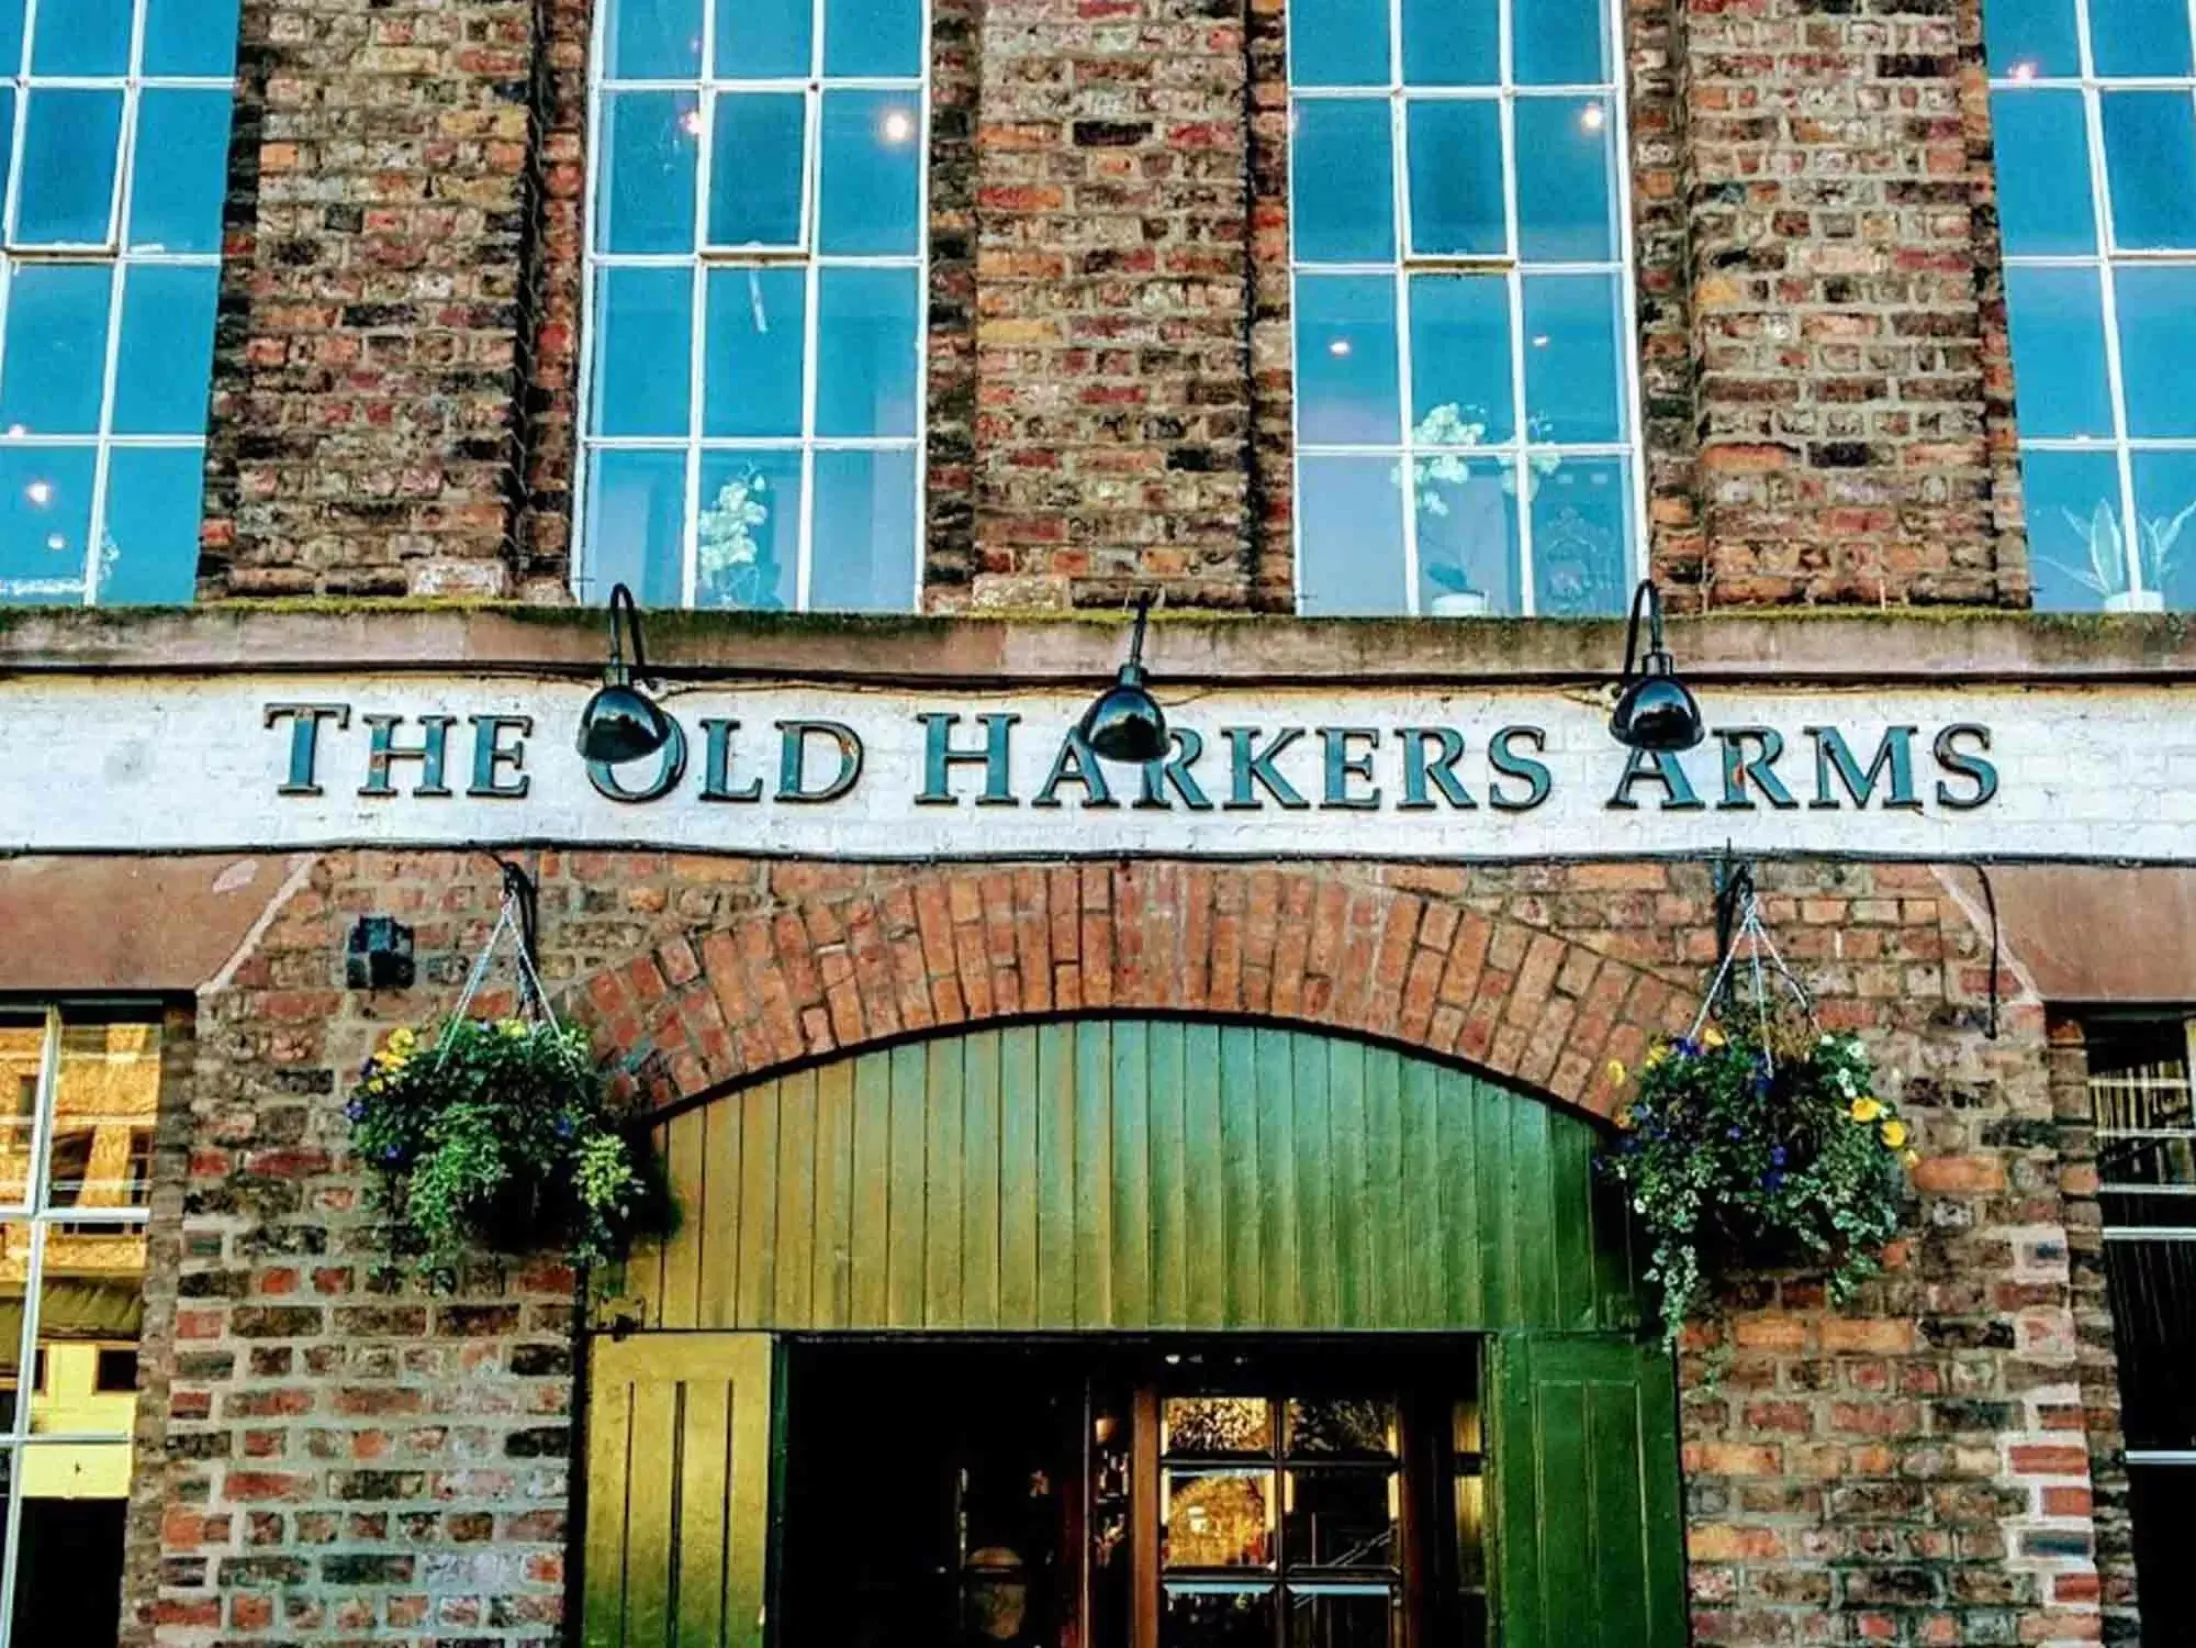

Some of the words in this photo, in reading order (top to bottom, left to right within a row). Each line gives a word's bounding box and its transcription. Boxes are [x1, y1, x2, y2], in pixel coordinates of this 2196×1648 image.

[264, 702, 534, 799] THE
[582, 709, 865, 804] OLD
[913, 711, 1553, 812] HARKERS
[1605, 723, 1999, 811] ARMS
